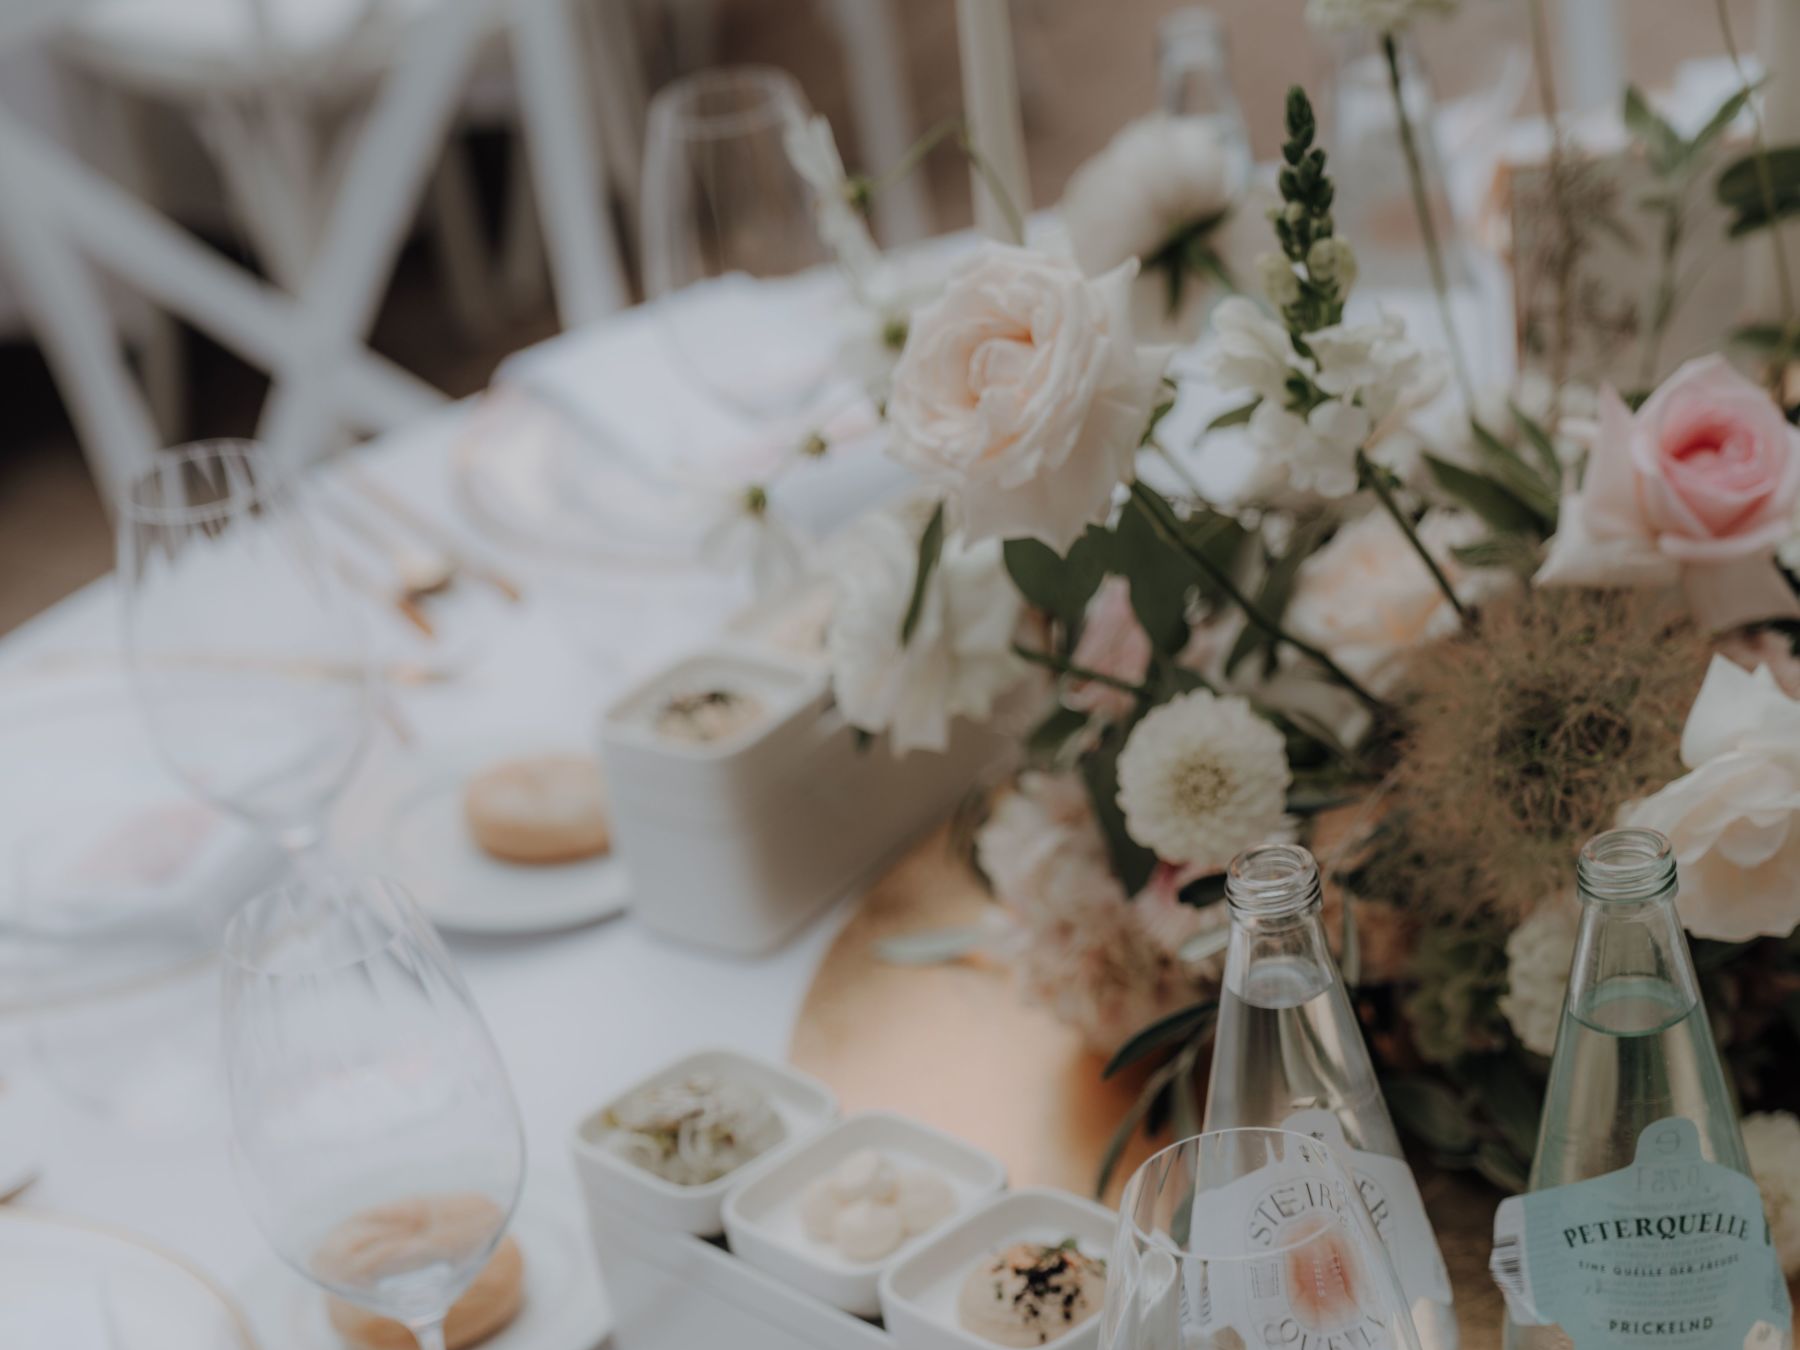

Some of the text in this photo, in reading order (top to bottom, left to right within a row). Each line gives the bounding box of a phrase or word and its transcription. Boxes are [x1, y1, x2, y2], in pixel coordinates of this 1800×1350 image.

[1563, 1212, 1749, 1249] PETERQUELLE
[1613, 1267, 1662, 1277] QUELLE
[1669, 1264, 1693, 1276] DER
[1609, 1316, 1714, 1335] PRICKELND
